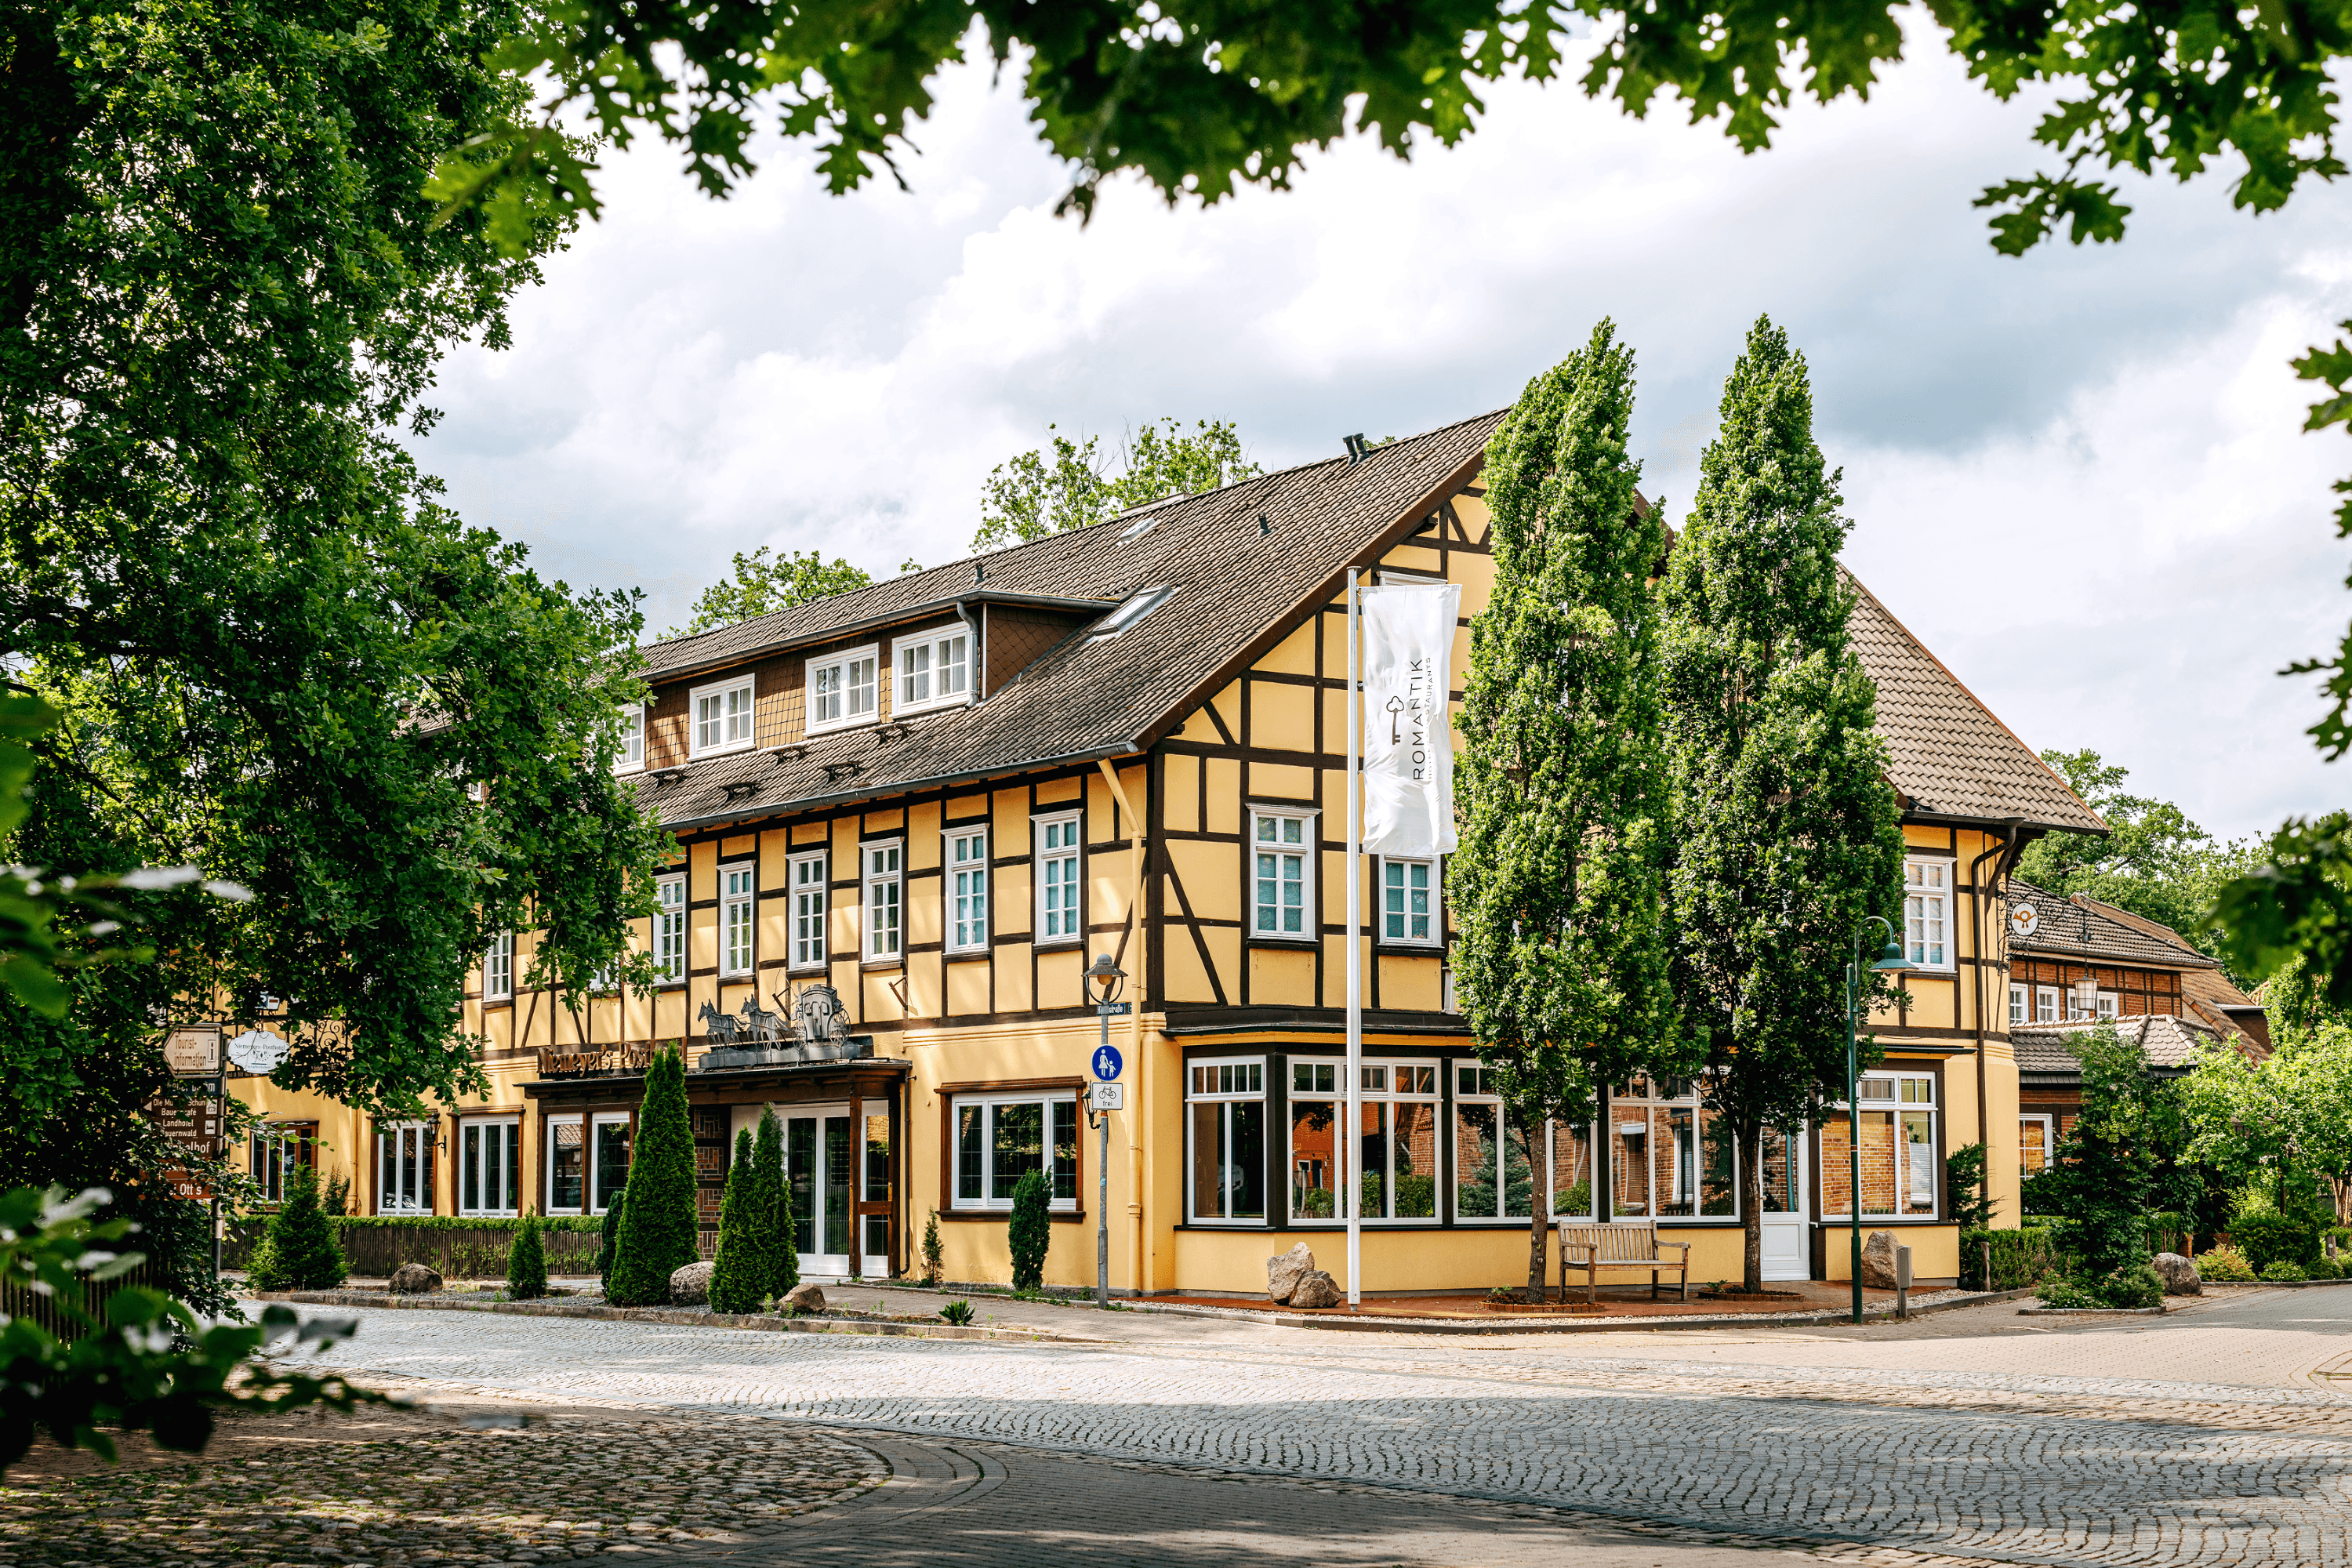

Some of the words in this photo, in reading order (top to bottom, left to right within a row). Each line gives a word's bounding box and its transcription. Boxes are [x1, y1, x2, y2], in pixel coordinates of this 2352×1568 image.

[1425, 657, 1433, 731] STAURANTS
[1410, 659, 1425, 780] ROMANTIK
[174, 1052, 207, 1068] information
[175, 1035, 197, 1049] Tourist-
[536, 1044, 614, 1078] Niemeyer's
[619, 1037, 688, 1069] Posthl
